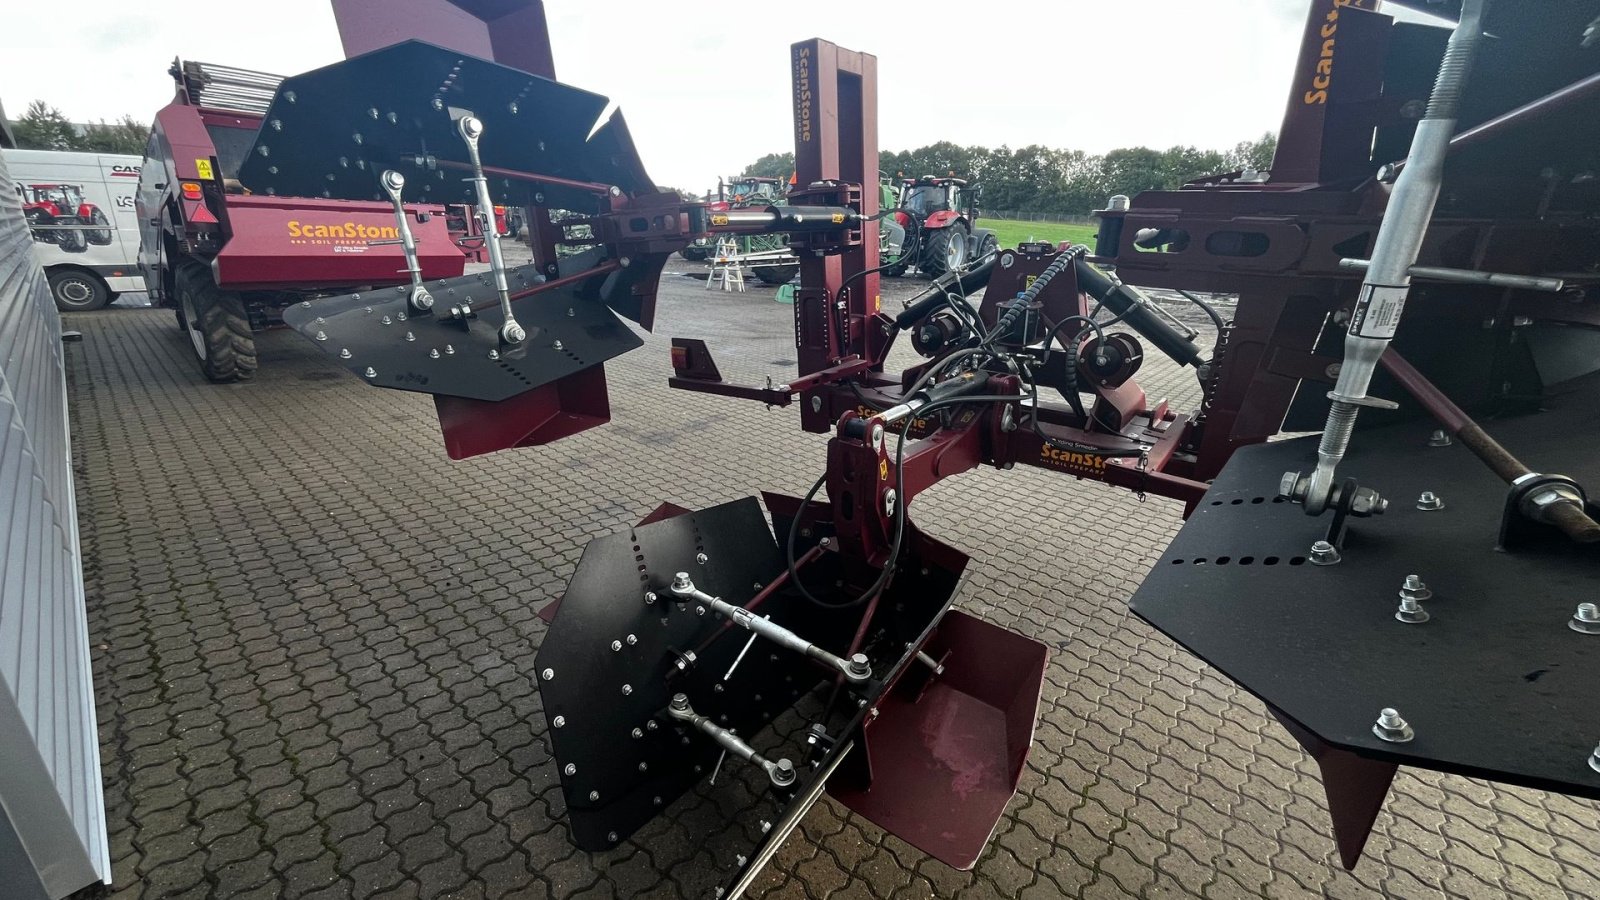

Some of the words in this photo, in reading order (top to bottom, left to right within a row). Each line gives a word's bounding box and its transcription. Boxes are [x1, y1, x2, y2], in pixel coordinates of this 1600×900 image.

[800, 47, 811, 142] ScanStone
[112, 165, 141, 173] CAS
[1041, 444, 1106, 469] ScanSt
